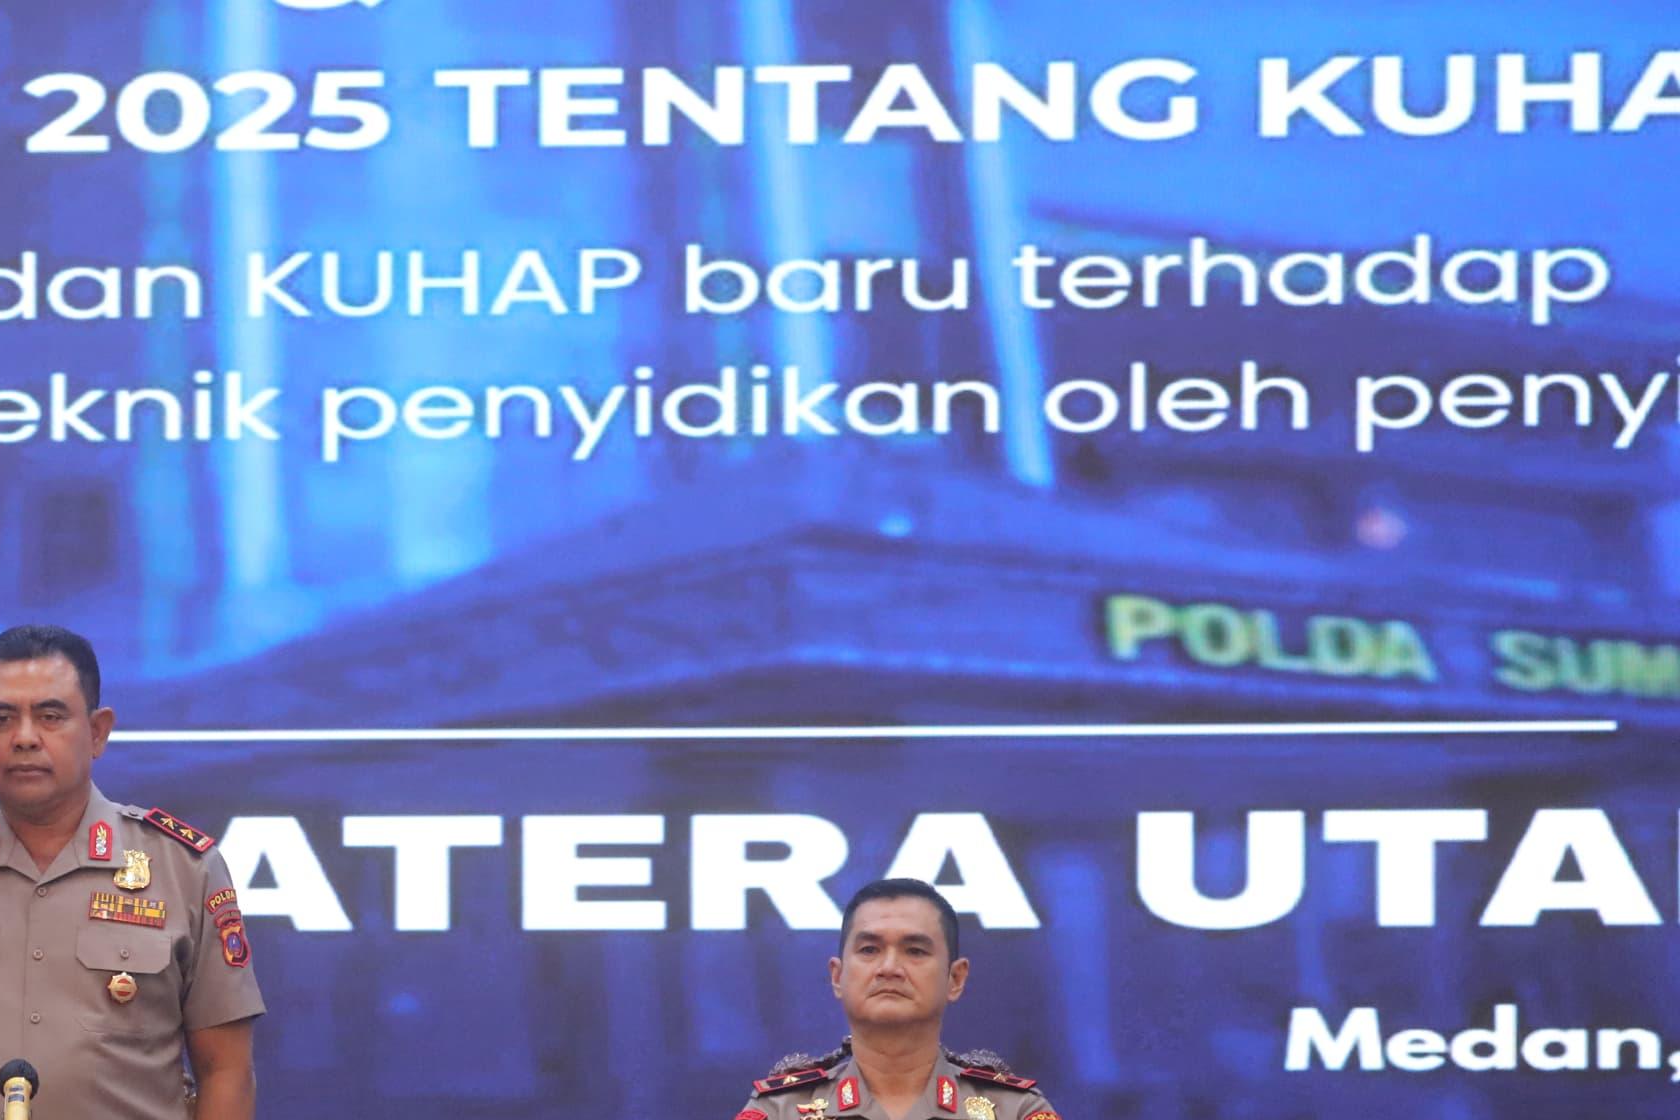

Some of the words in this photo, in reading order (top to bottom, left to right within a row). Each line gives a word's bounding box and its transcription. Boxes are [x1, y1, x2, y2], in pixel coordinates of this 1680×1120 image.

[23, 70, 390, 153] 2025
[434, 58, 1197, 148] TENTANG
[247, 249, 642, 318] KUHAP
[686, 244, 968, 314] baru
[1012, 234, 1609, 325] terhadap
[324, 365, 999, 461] penyidikan
[1044, 361, 1309, 433] oleh
[1106, 594, 1438, 682] POLDA
[209, 890, 236, 910] POLDA
[1137, 808, 1680, 929] UTA
